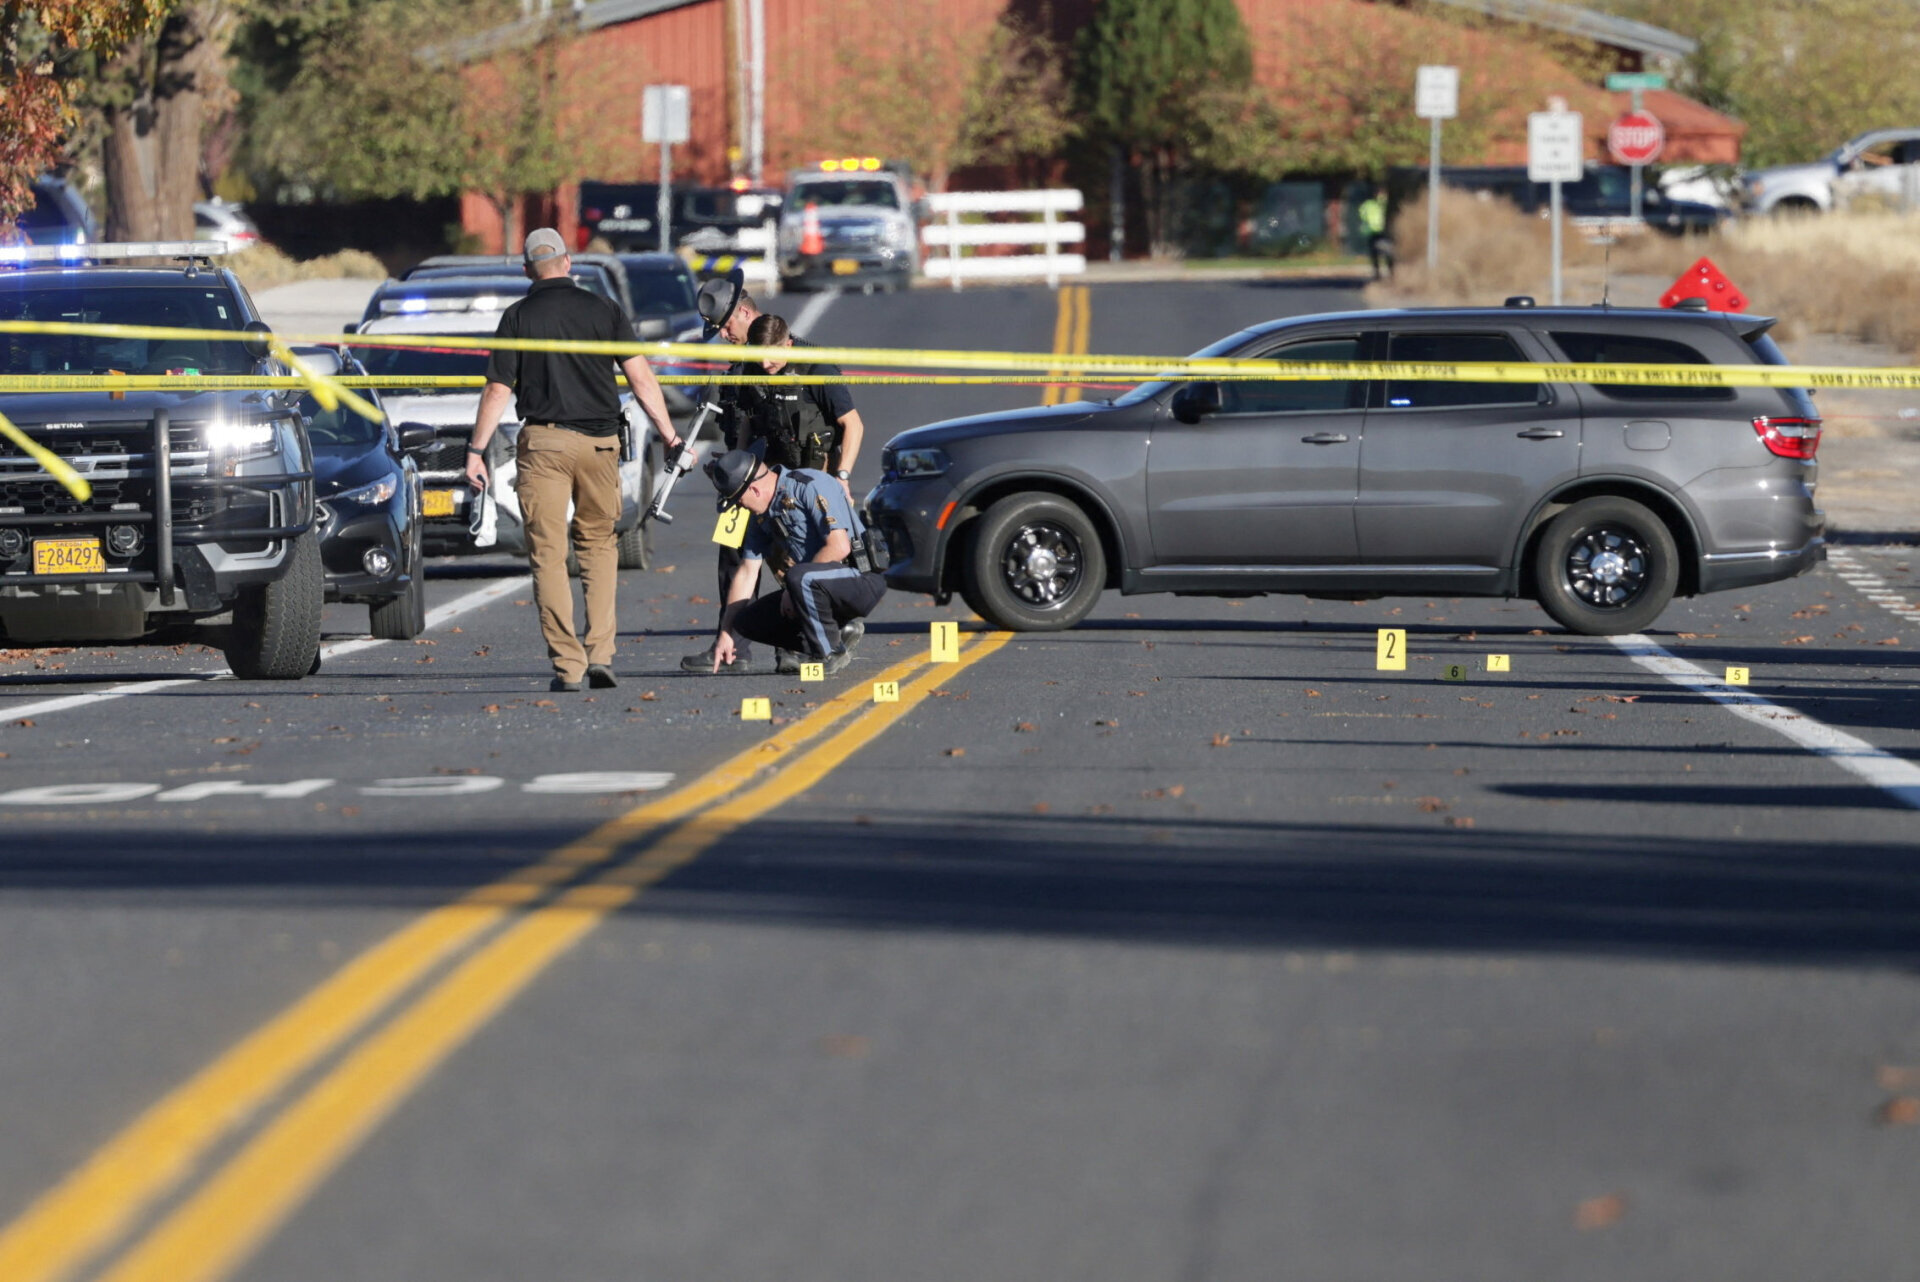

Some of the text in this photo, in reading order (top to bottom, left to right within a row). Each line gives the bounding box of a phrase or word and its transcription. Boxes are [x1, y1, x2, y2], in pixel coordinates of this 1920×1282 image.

[1611, 126, 1657, 148] STOP
[775, 393, 798, 401] POICE
[725, 507, 740, 534] 3
[38, 547, 101, 566] E284297
[939, 625, 946, 651] 1
[1386, 632, 1396, 659] 2
[1495, 656, 1501, 666] 7
[804, 666, 820, 677] 15
[1451, 666, 1459, 677] 6
[1734, 670, 1741, 681] 5
[878, 684, 894, 697] 14
[751, 701, 758, 712] 1
